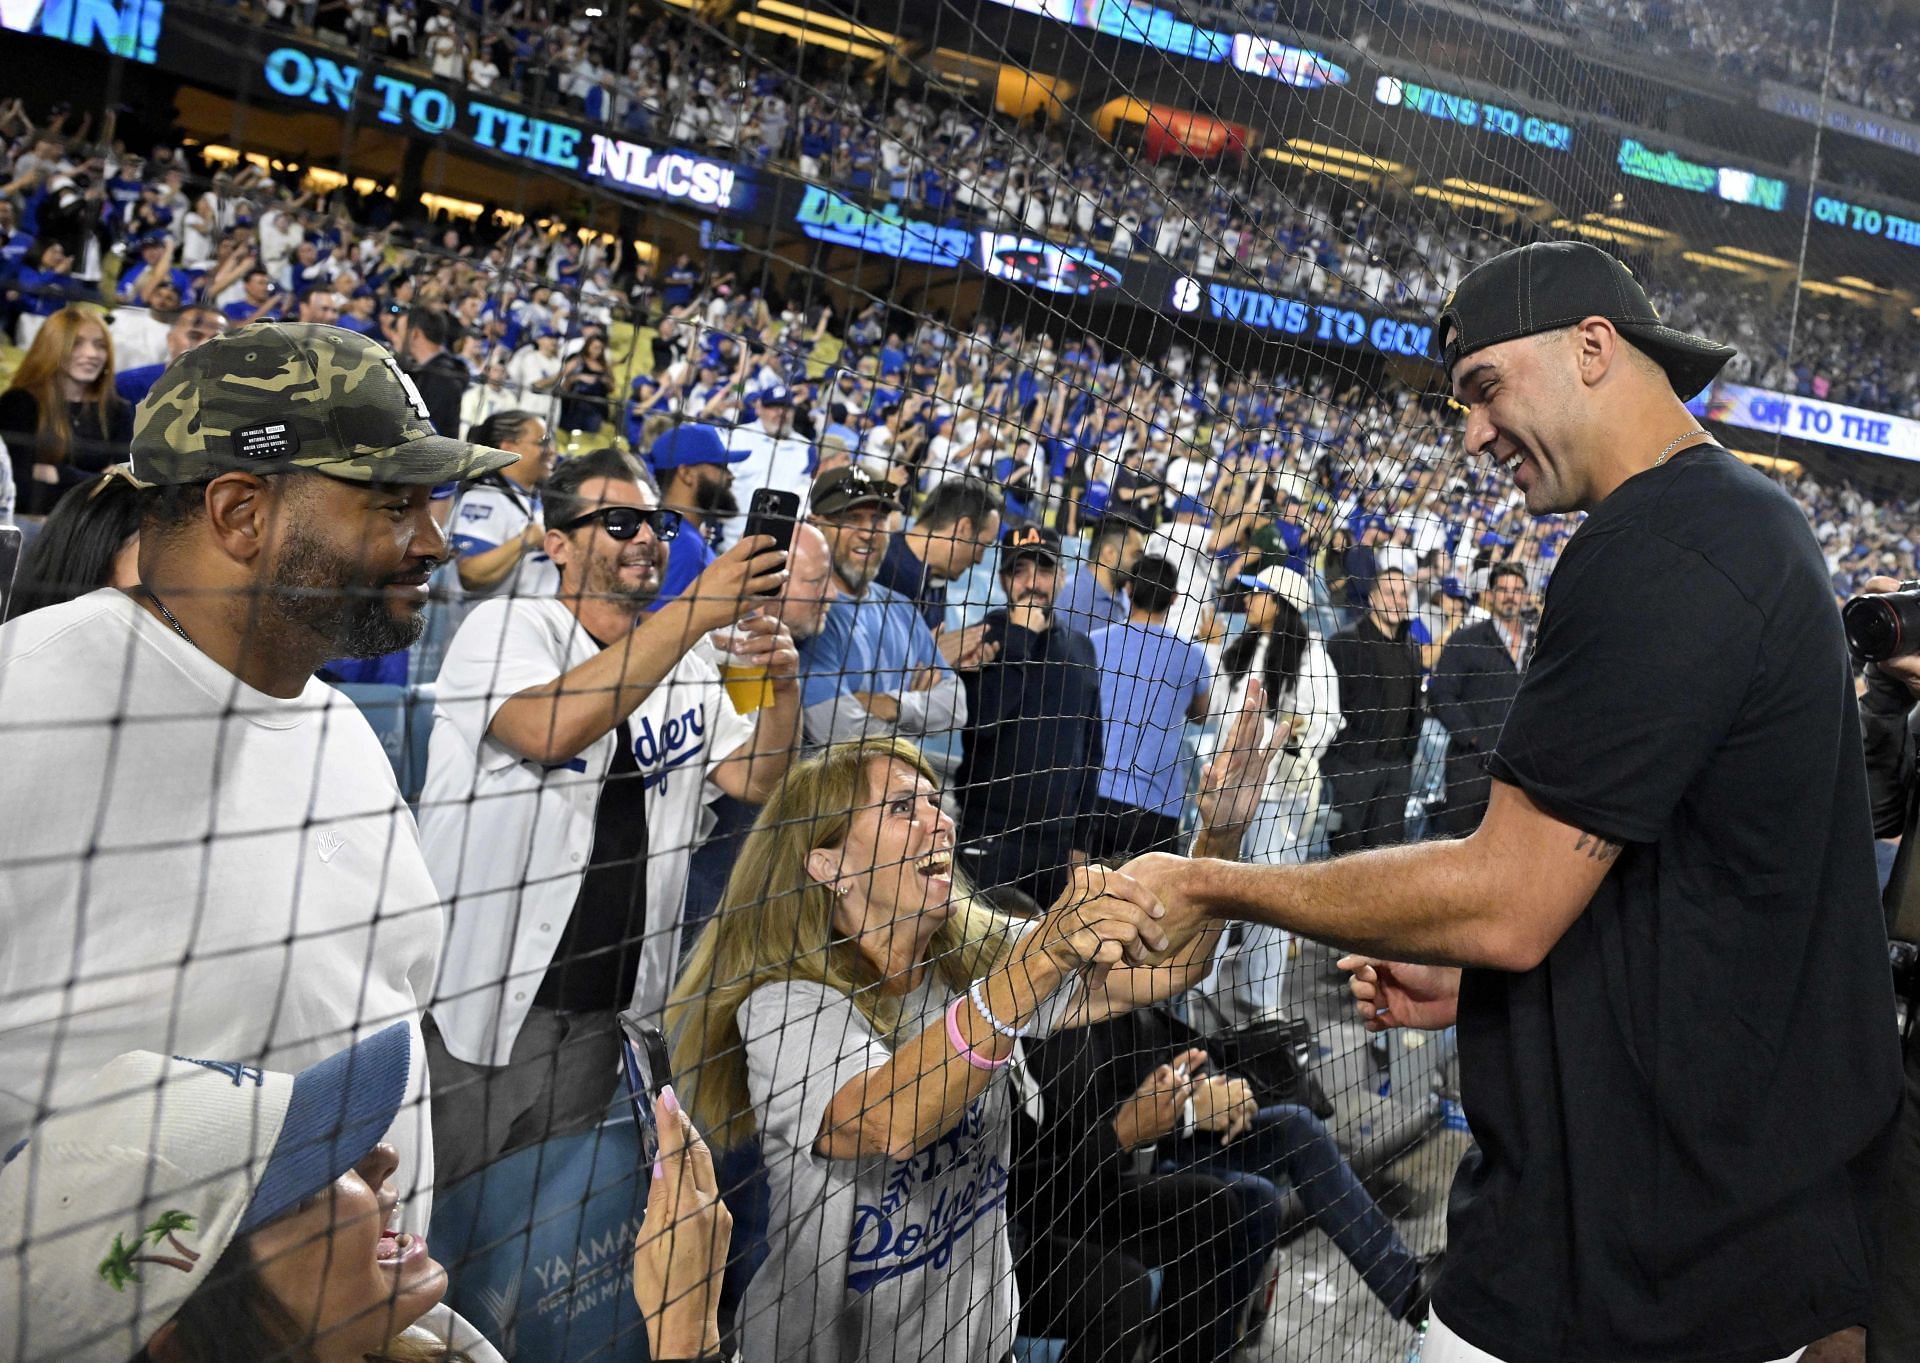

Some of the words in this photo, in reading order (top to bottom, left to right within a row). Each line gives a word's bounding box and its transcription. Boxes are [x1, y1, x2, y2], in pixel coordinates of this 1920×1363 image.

[264, 48, 362, 111] ON
[374, 74, 456, 134] TO
[468, 101, 581, 170] THE
[1480, 103, 1520, 137] TO
[1814, 196, 1850, 226] ON
[1851, 205, 1882, 235] TO
[1172, 276, 1201, 313] 8
[1208, 283, 1310, 334] WINS
[1315, 305, 1367, 345] TO
[1370, 317, 1432, 357] GO!
[1750, 397, 1789, 426] ON
[1799, 405, 1832, 434] TO
[1840, 413, 1891, 446] THE
